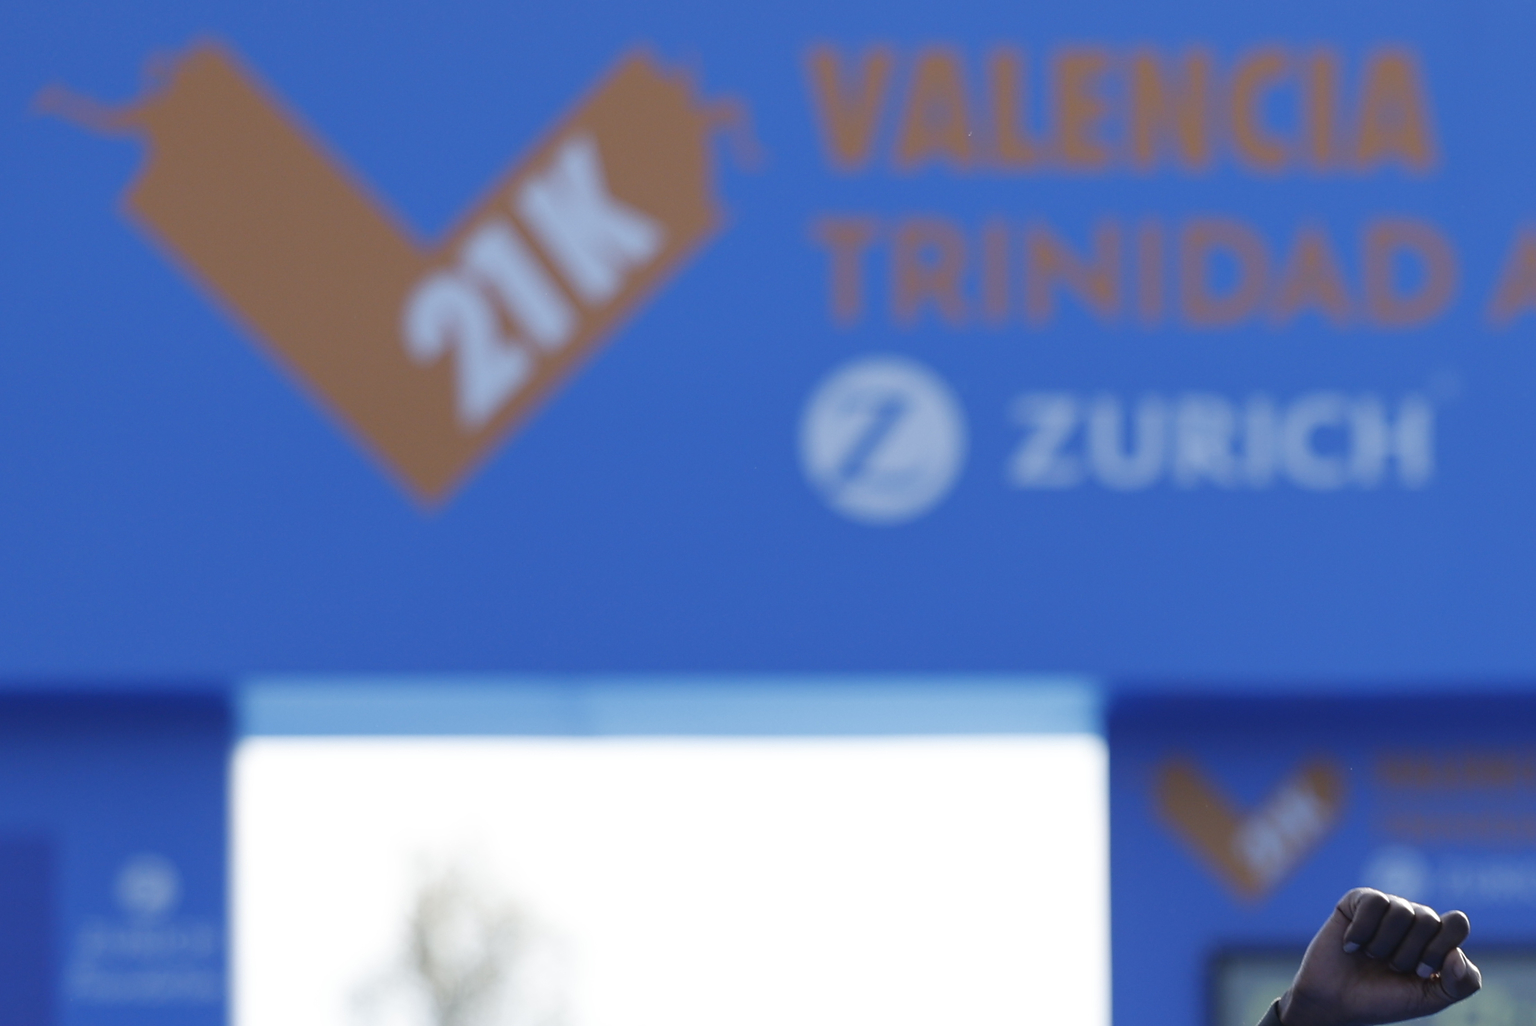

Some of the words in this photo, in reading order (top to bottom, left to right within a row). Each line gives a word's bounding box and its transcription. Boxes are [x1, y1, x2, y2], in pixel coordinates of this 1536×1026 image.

[808, 43, 1438, 172] VALENCIA
[402, 133, 666, 432] 21K
[812, 216, 1459, 328] TRINIDAD
[1012, 392, 1432, 490] ZURICH
